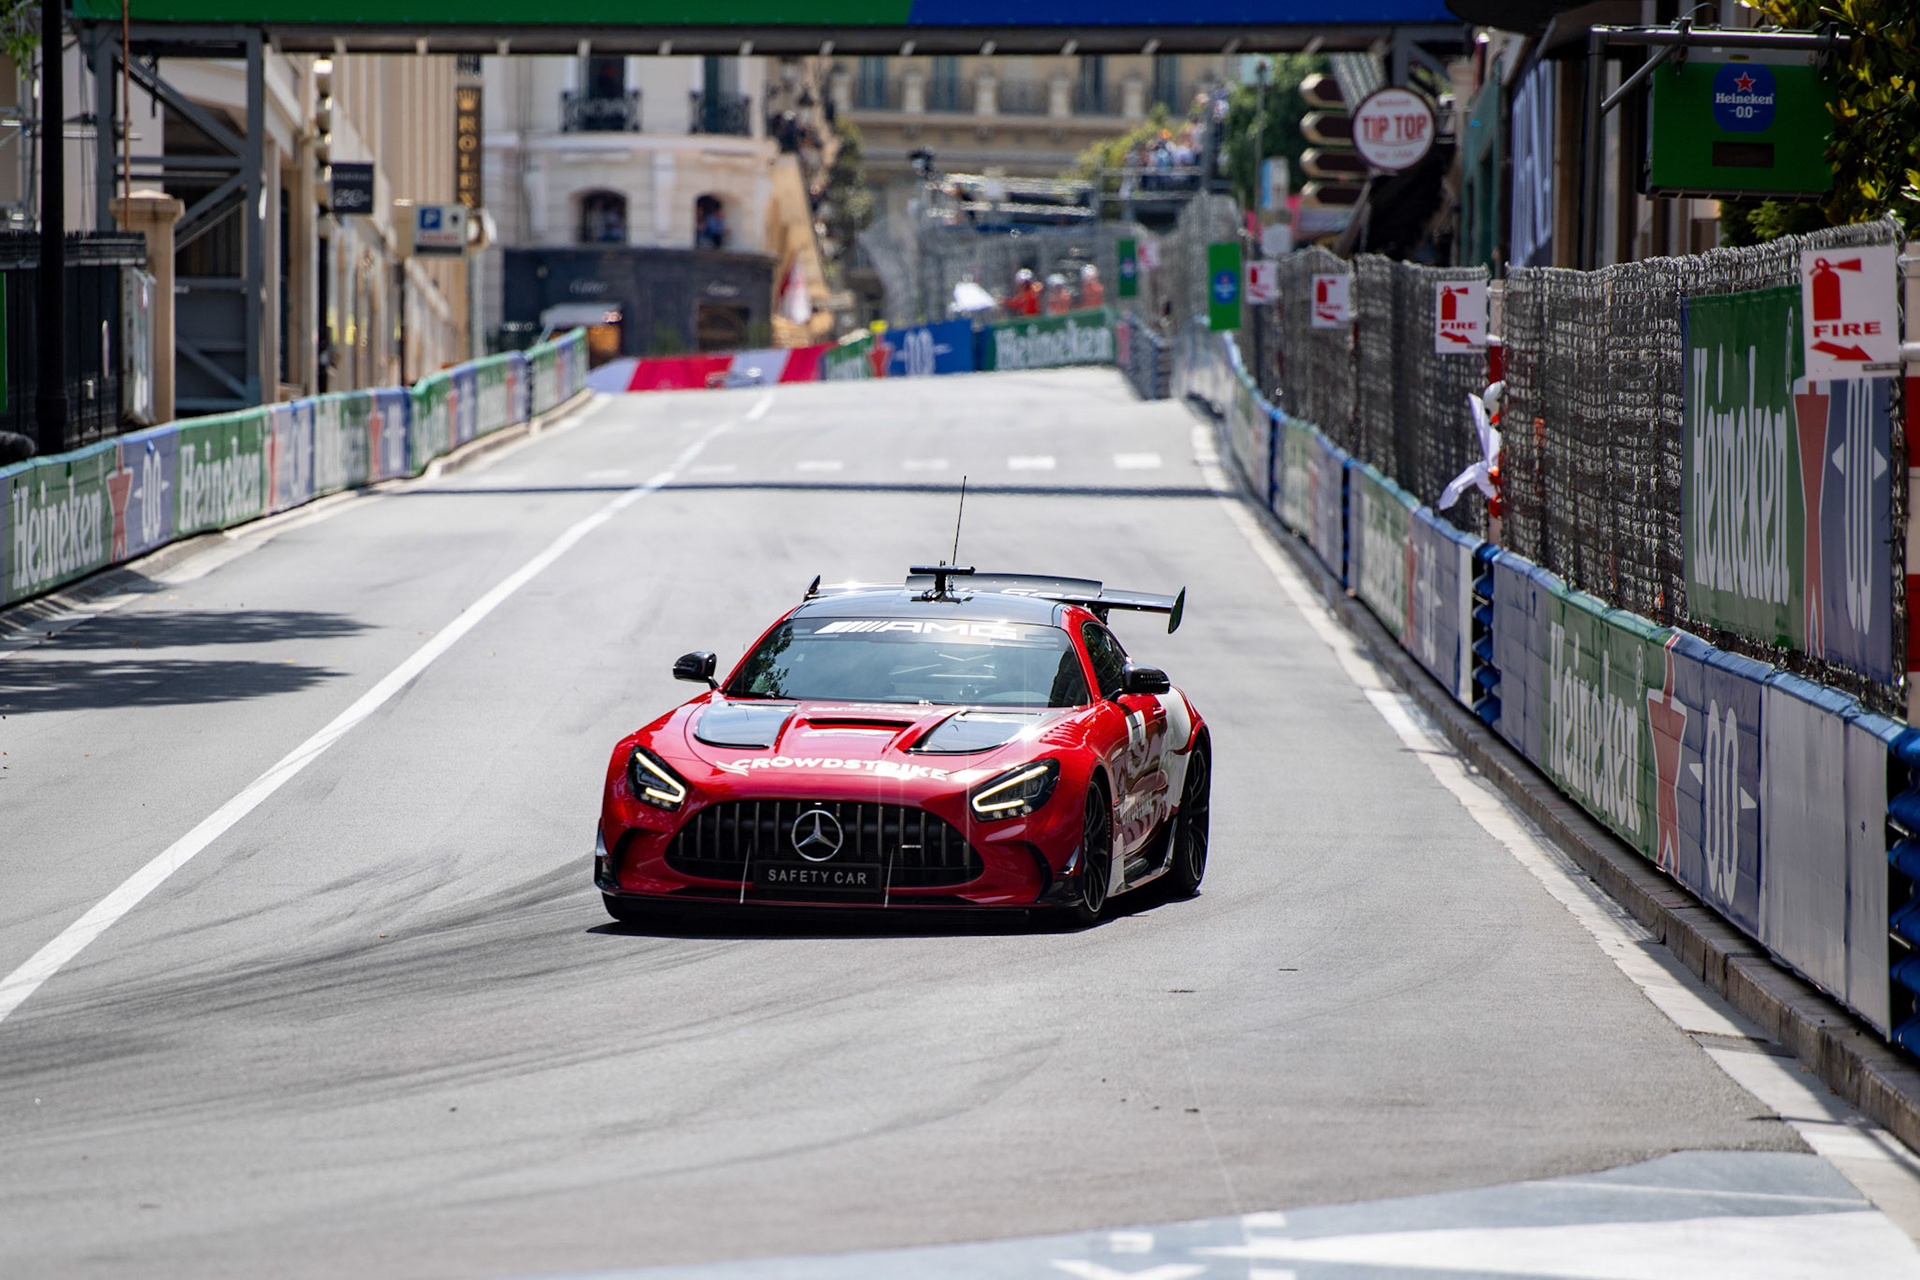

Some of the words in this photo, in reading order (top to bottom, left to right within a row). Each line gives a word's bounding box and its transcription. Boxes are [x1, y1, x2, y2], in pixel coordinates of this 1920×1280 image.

[1715, 93, 1773, 105] Heineken
[1362, 115, 1389, 141] TIP
[1395, 113, 1427, 140] TOP
[1441, 322, 1477, 330] FIRE
[1813, 322, 1882, 338] FIRE
[180, 435, 260, 531] Heineken
[1693, 343, 1789, 606] Heineken
[13, 475, 103, 589] Heineken
[875, 621, 1017, 638] AMG
[1551, 621, 1641, 835] Heineken
[731, 756, 950, 781] CROWDSTRIKE
[768, 869, 829, 883] SAFETY
[834, 872, 868, 885] CAR
